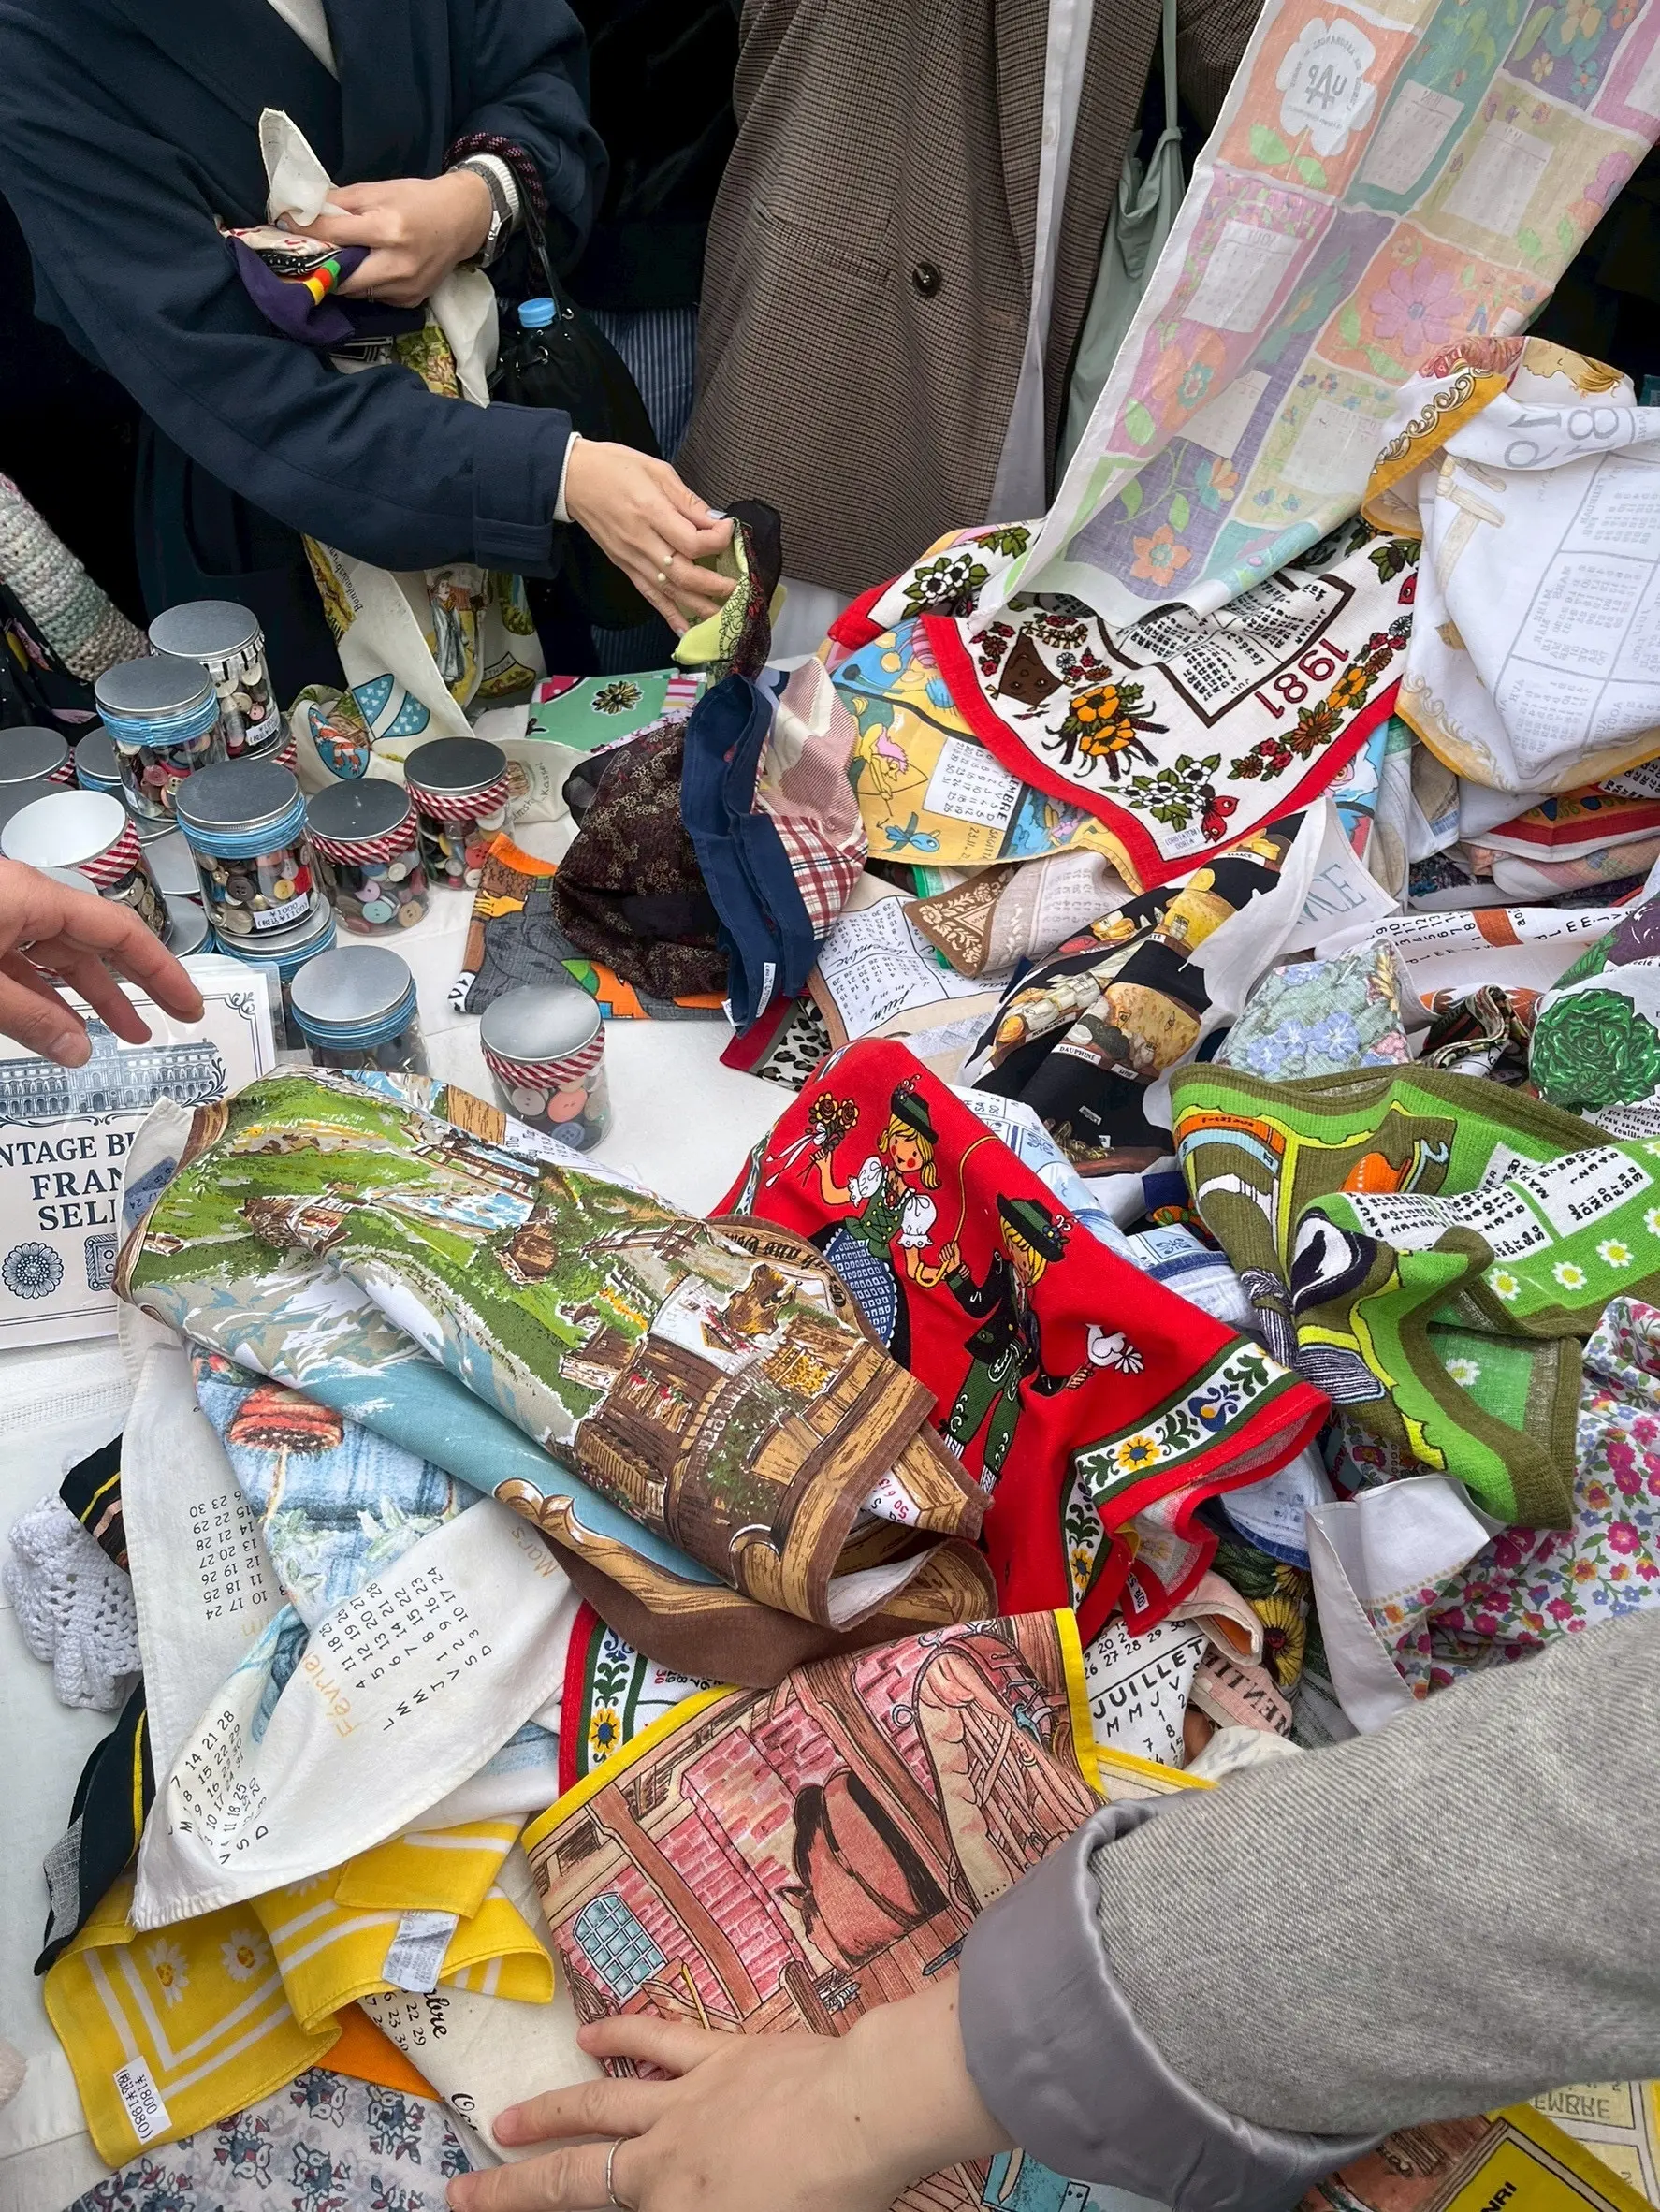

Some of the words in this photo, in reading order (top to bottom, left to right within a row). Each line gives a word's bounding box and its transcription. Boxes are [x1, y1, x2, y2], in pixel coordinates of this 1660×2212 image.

[1254, 638, 1349, 719] 1981
[269, 902, 298, 917] ¥1000
[1464, 923, 1476, 931] 8
[1566, 921, 1577, 932] m
[1580, 916, 1592, 928] m
[1389, 923, 1403, 936] 10
[211, 1496, 227, 1509] 23
[190, 1504, 206, 1517] 30
[236, 1506, 251, 1518] 15
[214, 1512, 230, 1526] 22
[193, 1521, 209, 1534] 29
[240, 1521, 255, 1535] 14
[218, 1530, 232, 1543] 21
[197, 1537, 211, 1551] 28
[243, 1538, 257, 1551] 13
[219, 1546, 236, 1560] 20
[199, 1554, 214, 1569] 27
[246, 1556, 261, 1569] 12
[225, 1563, 238, 1577] 19
[427, 1566, 444, 1584] 24
[201, 1571, 217, 1585] 26
[251, 1573, 262, 1586] 11
[226, 1580, 240, 1594] 18
[366, 1582, 382, 1598] 28
[411, 1577, 428, 1595] 23
[204, 1588, 220, 1603] 25
[253, 1591, 268, 1604] 10
[394, 1588, 412, 1607] 22
[440, 1590, 456, 1603] 17
[229, 1598, 244, 1612] 17
[350, 1596, 365, 1610] 27
[378, 1600, 394, 1617] 21
[425, 1597, 441, 1614] 16
[206, 1605, 222, 1620] 24
[336, 1608, 349, 1623] 26
[406, 1608, 424, 1626] 15
[453, 1607, 469, 1623] 10
[361, 1610, 378, 1630] 20
[439, 1621, 452, 1631] 9
[319, 1623, 332, 1637] 25
[344, 1624, 361, 1640] 19
[391, 1621, 407, 1638] 14
[468, 1629, 479, 1638] 3
[328, 1637, 343, 1652] 18
[374, 1632, 390, 1650] 13
[422, 1632, 434, 1643] 8
[404, 1646, 418, 1656] 7
[452, 1639, 465, 1651] 2
[481, 1645, 492, 1656] D
[1098, 1638, 1114, 1654] 20
[1103, 1650, 1119, 1666] 27
[1125, 1640, 1142, 1655] 28
[1147, 1629, 1162, 1643] 29
[357, 1643, 374, 1662] 12
[436, 1652, 448, 1662] 1
[341, 1656, 357, 1672] 11
[389, 1656, 401, 1666] 6
[465, 1655, 477, 1666] S
[371, 1667, 385, 1680] 5
[446, 1668, 460, 1681] V
[655, 1669, 667, 1684] 30
[1093, 1638, 1202, 1719] JUILLET
[356, 1680, 366, 1689] 4
[430, 1681, 444, 1692] J
[413, 1688, 429, 1705] M
[1178, 1694, 1186, 1709] 2
[396, 1701, 412, 1716] M
[1106, 1716, 1119, 1737] M
[1129, 1702, 1143, 1723] M
[1151, 1691, 1159, 1707] J
[1169, 1676, 1180, 1691] V
[383, 1717, 395, 1731] L
[185, 1753, 202, 1771] 14
[202, 1732, 219, 1750] 21
[217, 1710, 235, 1731] 28
[1143, 1737, 1154, 1752] 7
[1166, 1724, 1175, 1738] 8
[183, 1790, 193, 1802] 8
[198, 1766, 212, 1784] 15
[214, 1744, 228, 1765] 22
[195, 1804, 202, 1816] 9
[207, 1783, 219, 1798] 16
[206, 1814, 217, 1830] 10
[213, 1793, 225, 1812] 17
[227, 1805, 240, 1817] 18
[255, 1826, 269, 1840] D
[236, 1838, 249, 1851] S
[388, 2009, 401, 2029] 23
[395, 2034, 409, 2052] 30
[406, 2001, 419, 2022] 22
[413, 2027, 427, 2046] 29
[135, 2074, 158, 2115] ¥1800
[116, 2069, 153, 2139] (税込¥1980)
